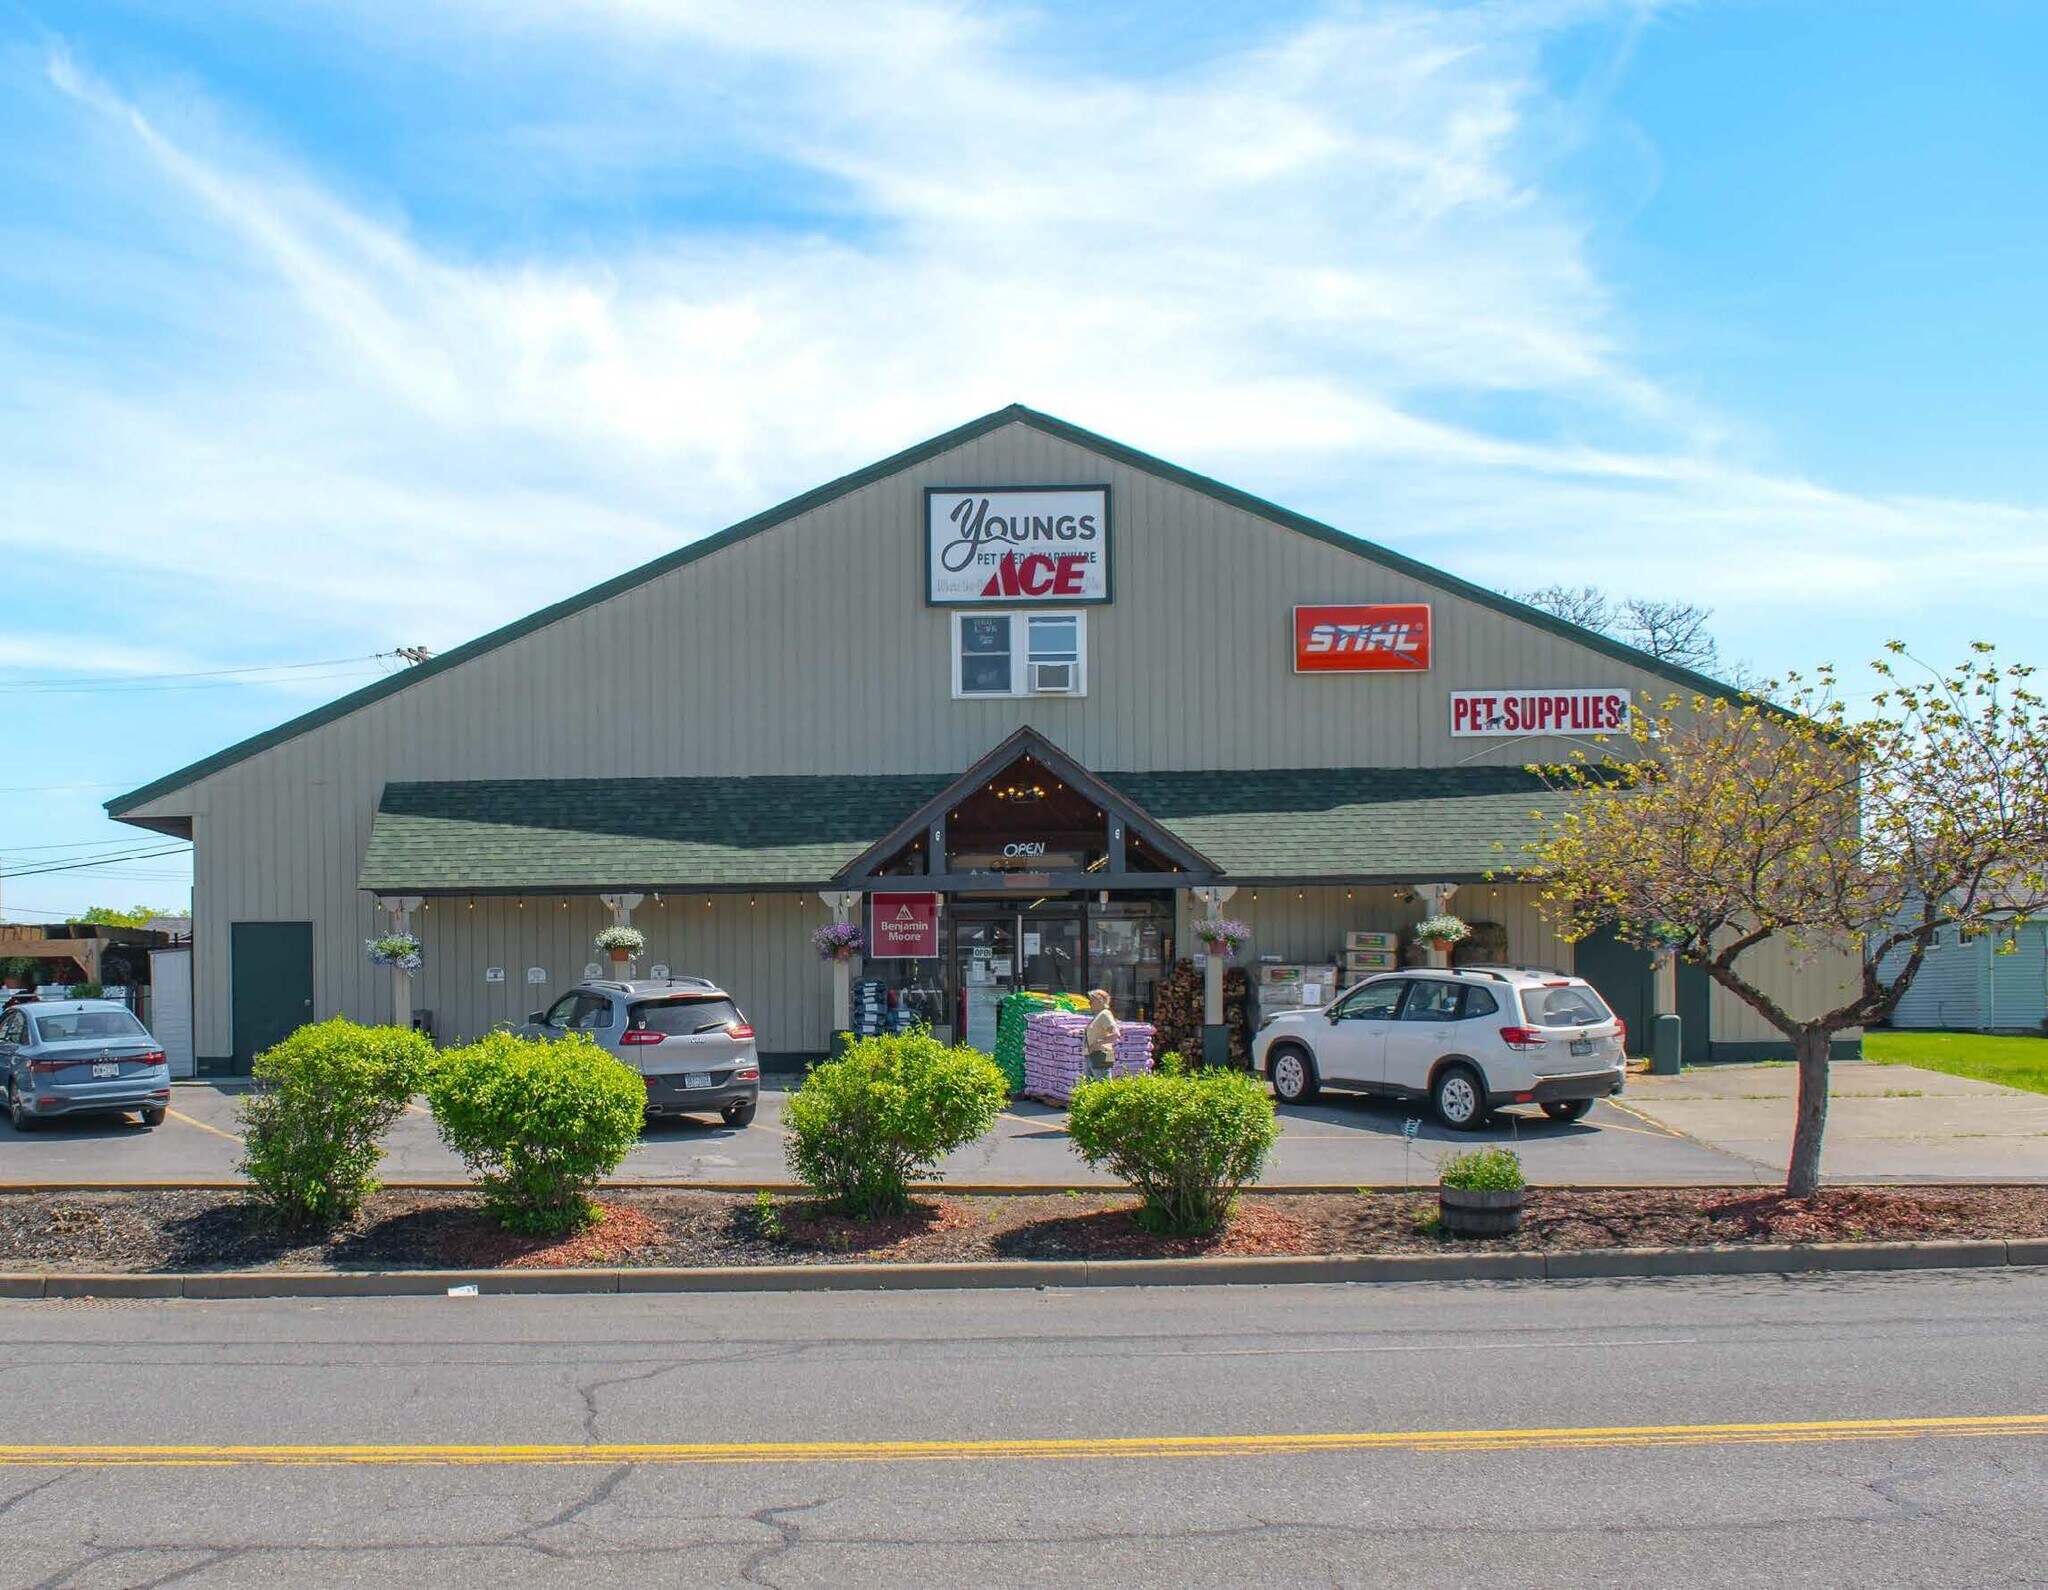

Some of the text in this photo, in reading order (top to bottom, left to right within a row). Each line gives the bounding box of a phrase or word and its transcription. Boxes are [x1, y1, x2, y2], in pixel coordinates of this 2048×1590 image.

[977, 553, 996, 565] PET
[1000, 552, 1025, 565] FED
[980, 548, 1090, 597] ACE
[1305, 623, 1420, 652] STIHL
[1453, 694, 1621, 731] PET SUPPLIES
[1003, 842, 1046, 857] OPEN
[881, 921, 929, 933] Benjamin
[888, 932, 922, 941] Moore
